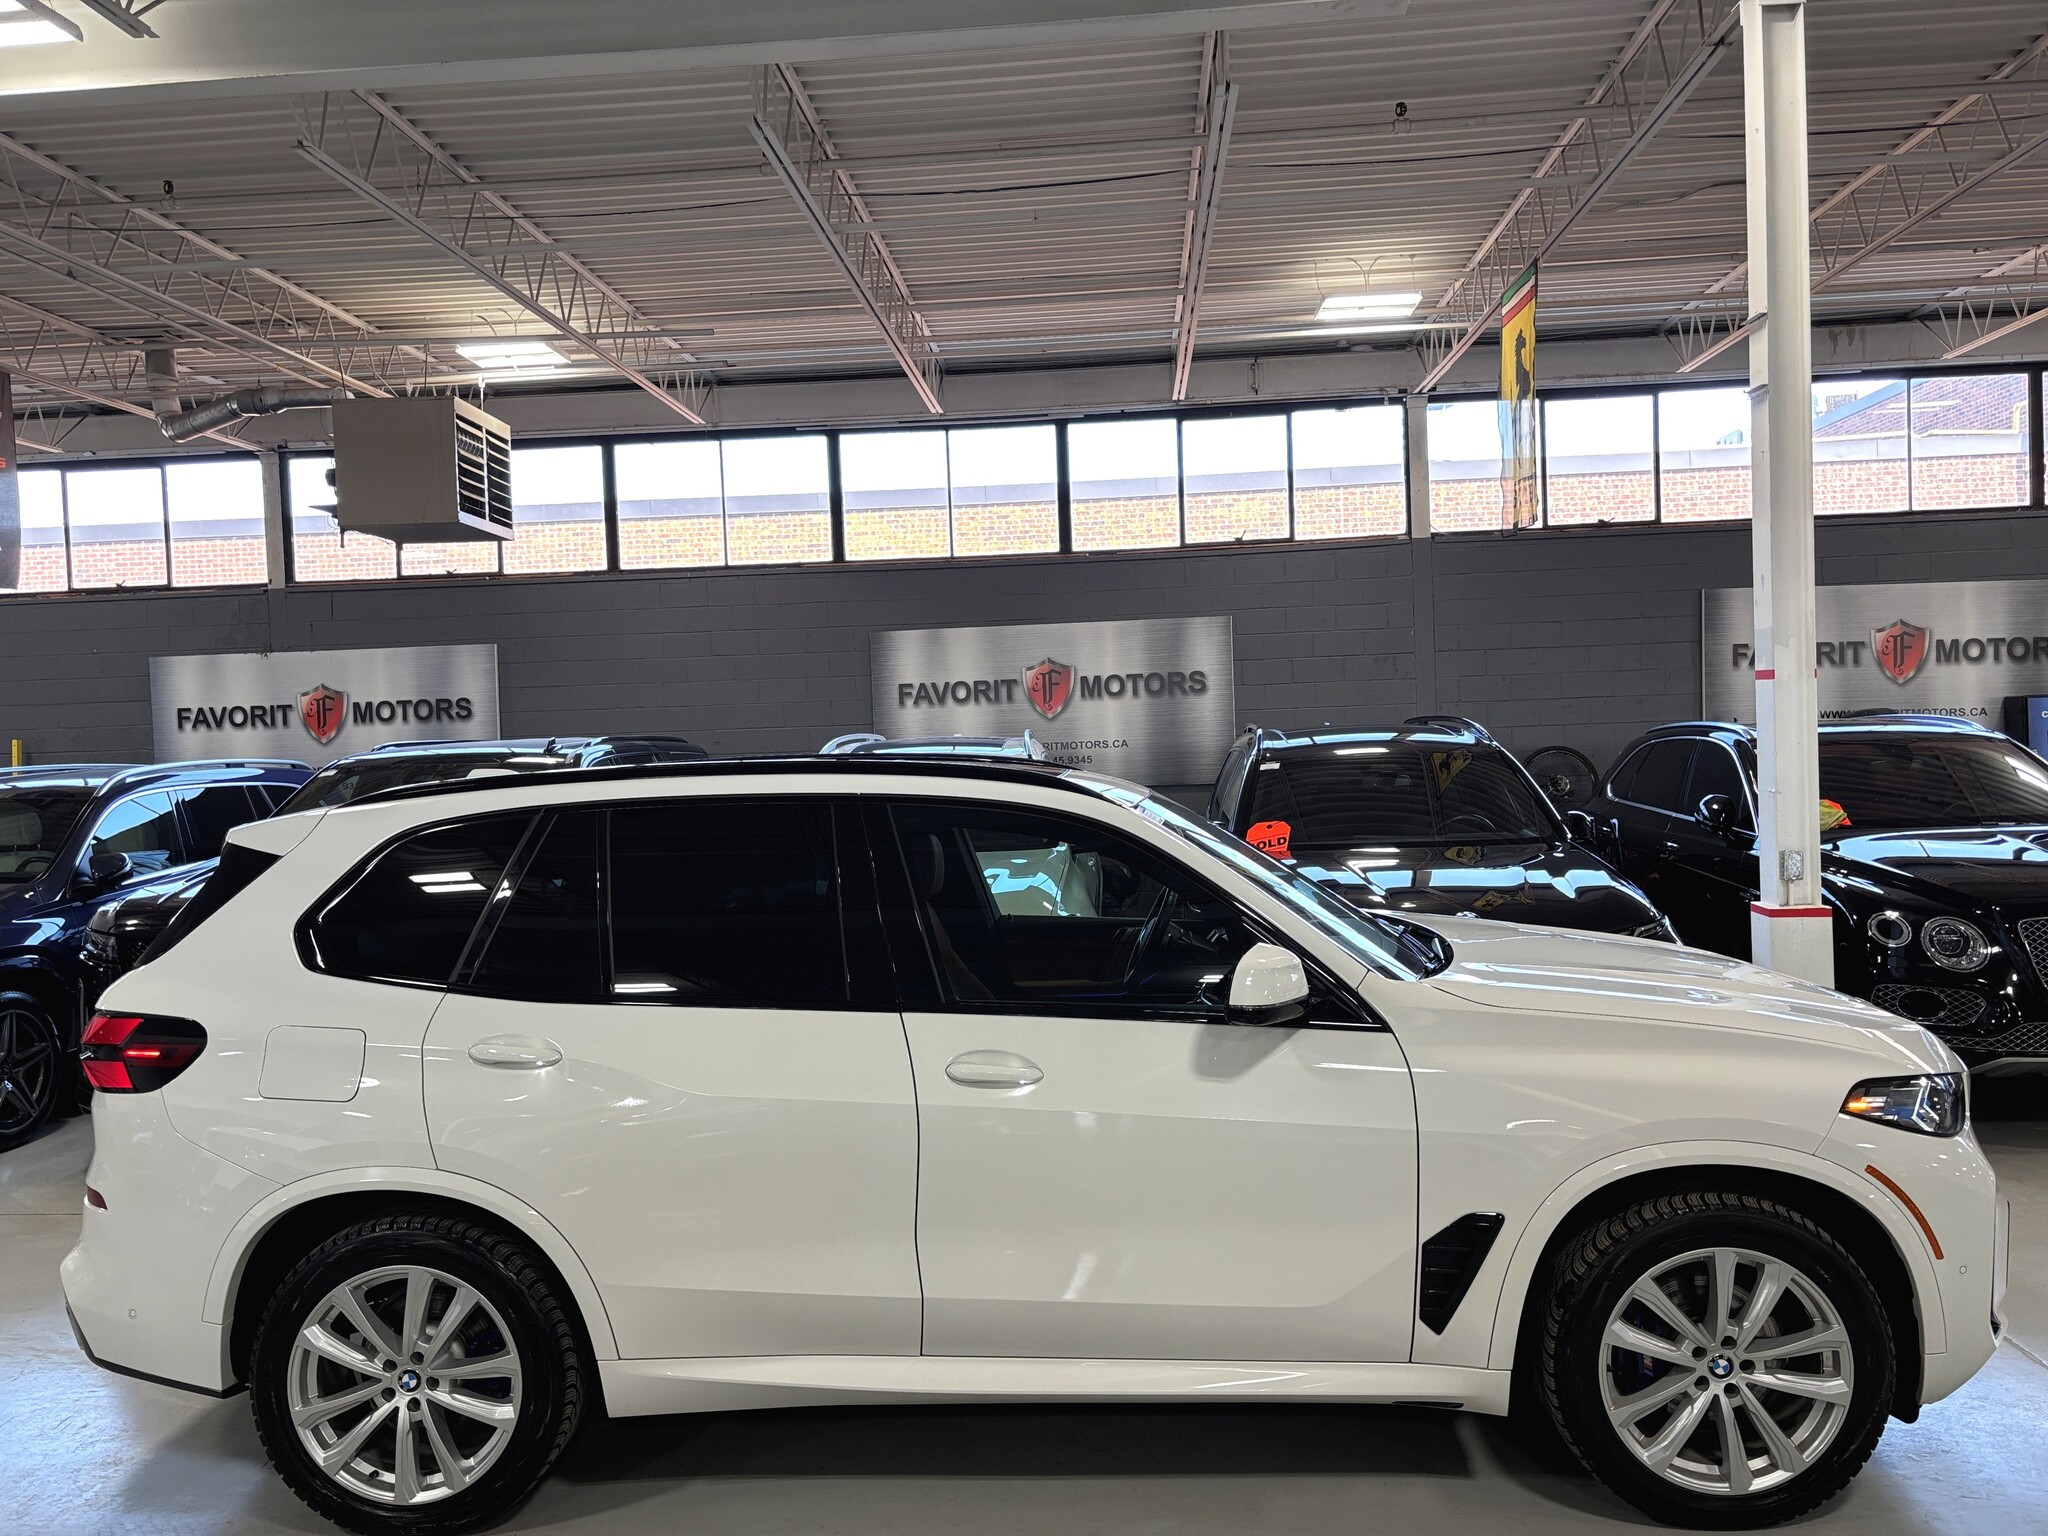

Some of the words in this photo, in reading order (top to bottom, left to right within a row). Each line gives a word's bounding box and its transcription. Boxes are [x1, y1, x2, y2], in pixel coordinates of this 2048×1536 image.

[1732, 641, 1866, 667] FRIT
[1935, 636, 2048, 662] MOTOR
[898, 678, 1018, 705] FAVORIT
[1080, 671, 1207, 698] MOTORS
[177, 704, 293, 729] FAVORIT
[352, 697, 473, 723] MOTORS
[1042, 739, 1129, 751] RITMOTORS.CA
[1052, 755, 1093, 765] 45.9345
[1256, 836, 1288, 850] OLD
